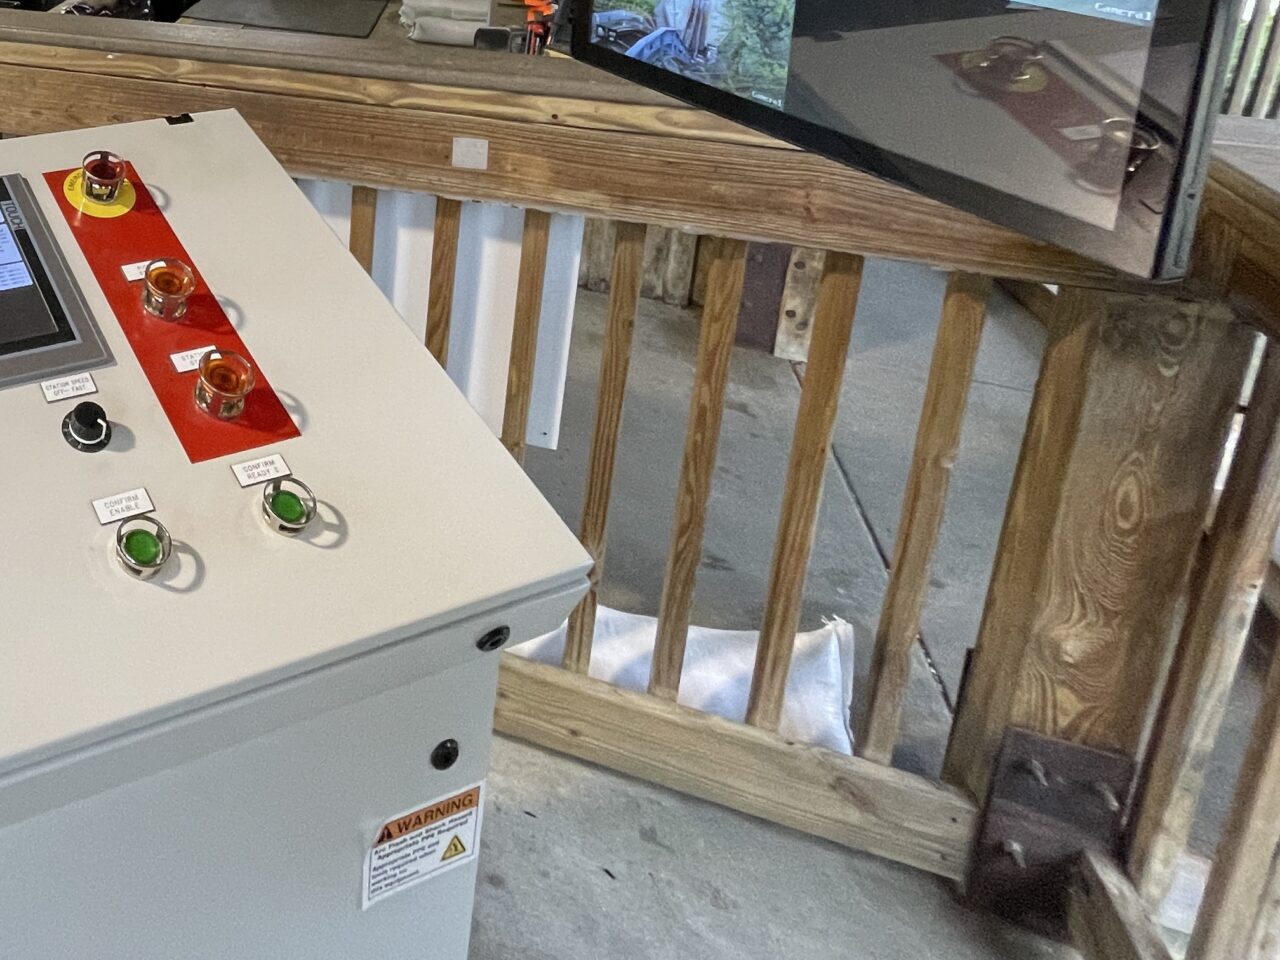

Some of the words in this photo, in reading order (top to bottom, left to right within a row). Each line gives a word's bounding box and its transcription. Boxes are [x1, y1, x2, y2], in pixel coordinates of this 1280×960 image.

[243, 459, 275, 472] CONFIRM
[247, 469, 271, 479] READY
[104, 494, 140, 509] CONFIRM
[109, 502, 141, 517] ENABLE
[396, 793, 473, 834] WARNING
